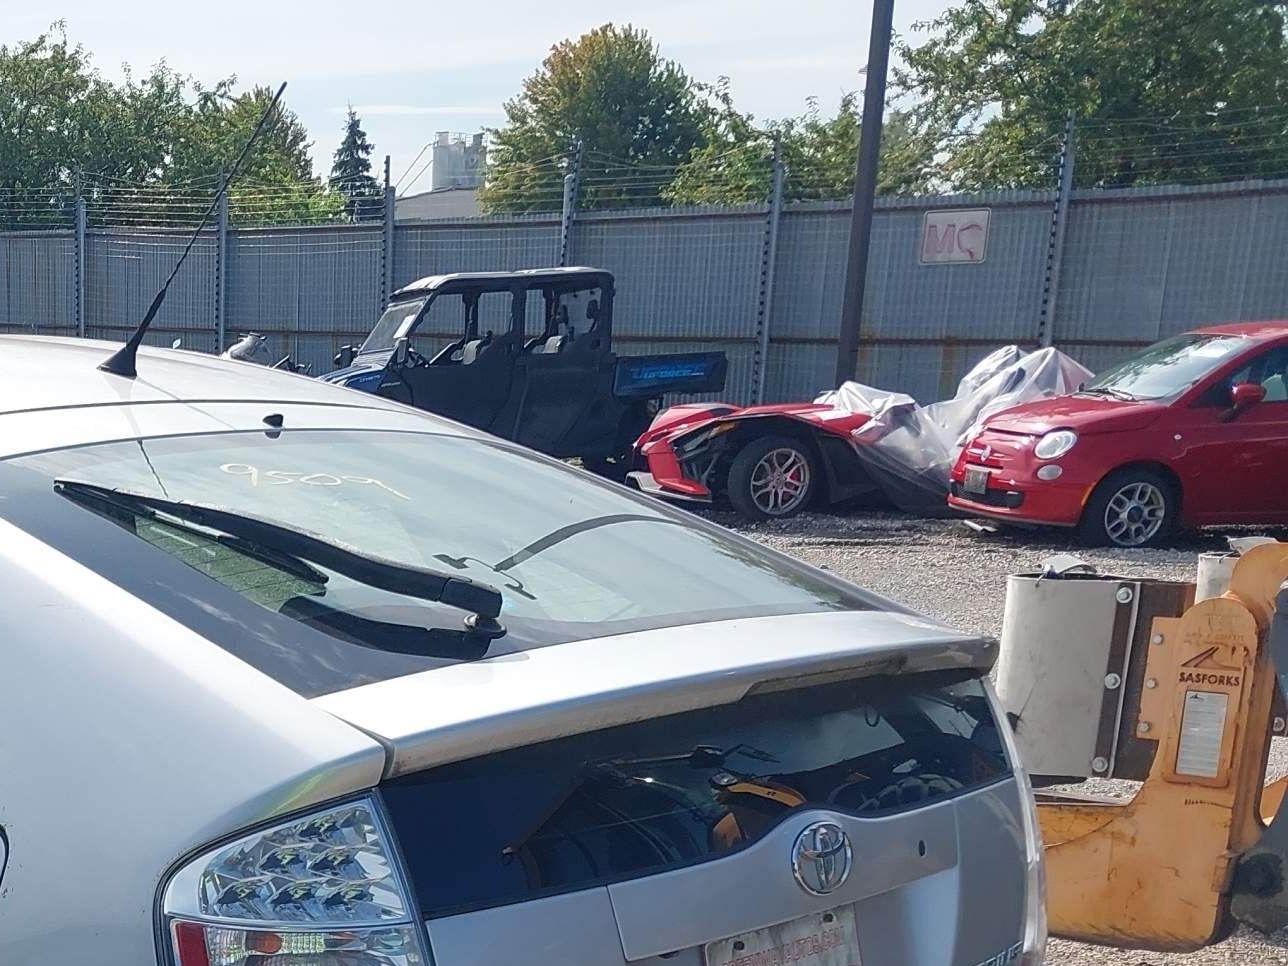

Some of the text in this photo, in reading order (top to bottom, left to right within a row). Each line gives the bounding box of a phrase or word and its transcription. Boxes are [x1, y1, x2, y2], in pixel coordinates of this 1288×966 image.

[925, 224, 983, 260] MC
[219, 463, 412, 501] 9509
[1178, 671, 1240, 687] SASFORKS
